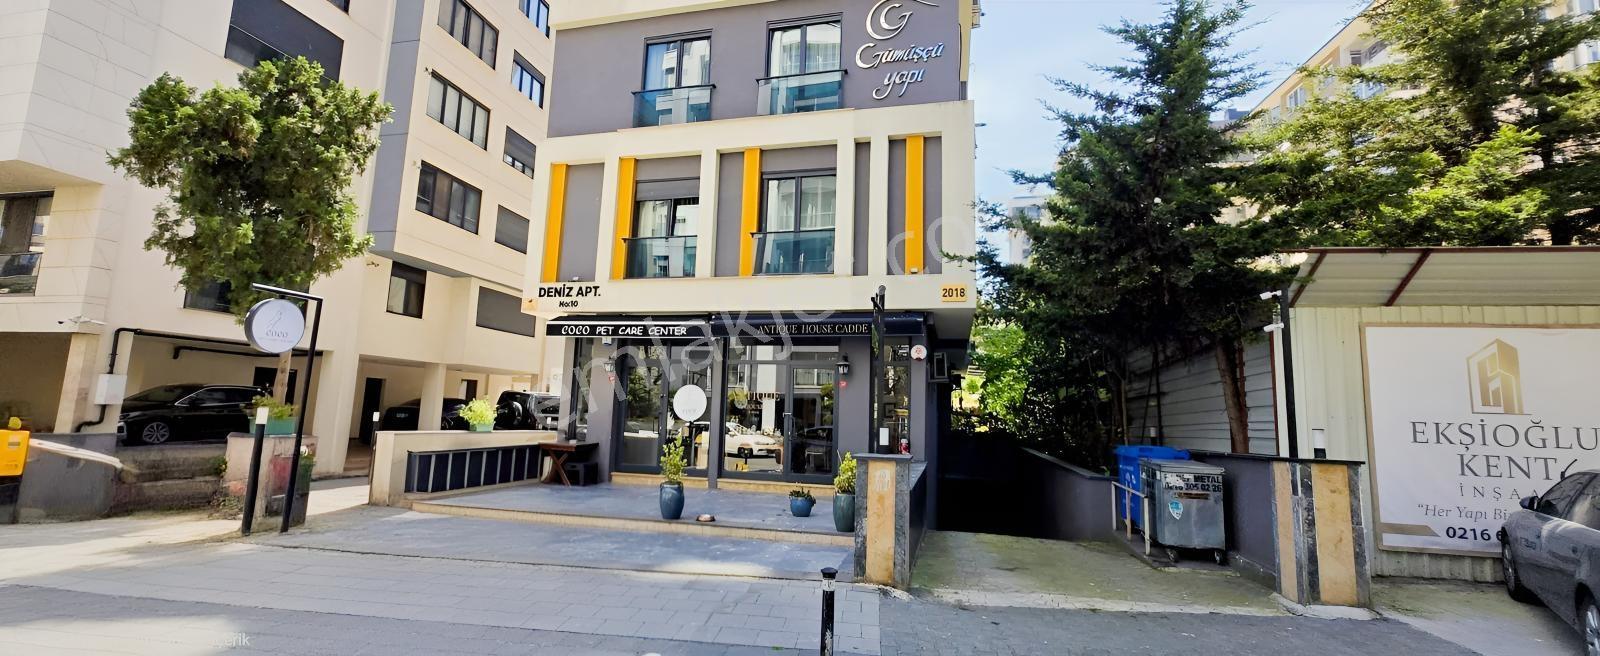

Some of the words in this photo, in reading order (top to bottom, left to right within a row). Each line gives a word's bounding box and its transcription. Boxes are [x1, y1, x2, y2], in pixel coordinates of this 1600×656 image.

[538, 284, 573, 298] DENİZ
[576, 286, 601, 298] APT.
[942, 287, 966, 298] 2018
[561, 325, 590, 335] COCO
[596, 325, 614, 335] PET
[618, 325, 643, 335] CARE
[648, 325, 687, 336] CENTER
[757, 324, 798, 335] ANTIQUE
[801, 324, 834, 334] HOUSE
[835, 324, 869, 333] CADDE
[1410, 417, 1600, 453] EKŞİOĞLU
[1457, 453, 1558, 481] KENT
[1455, 506, 1488, 523] Yapı
[1493, 508, 1510, 521] Bi
[1446, 527, 1492, 542] 0216
